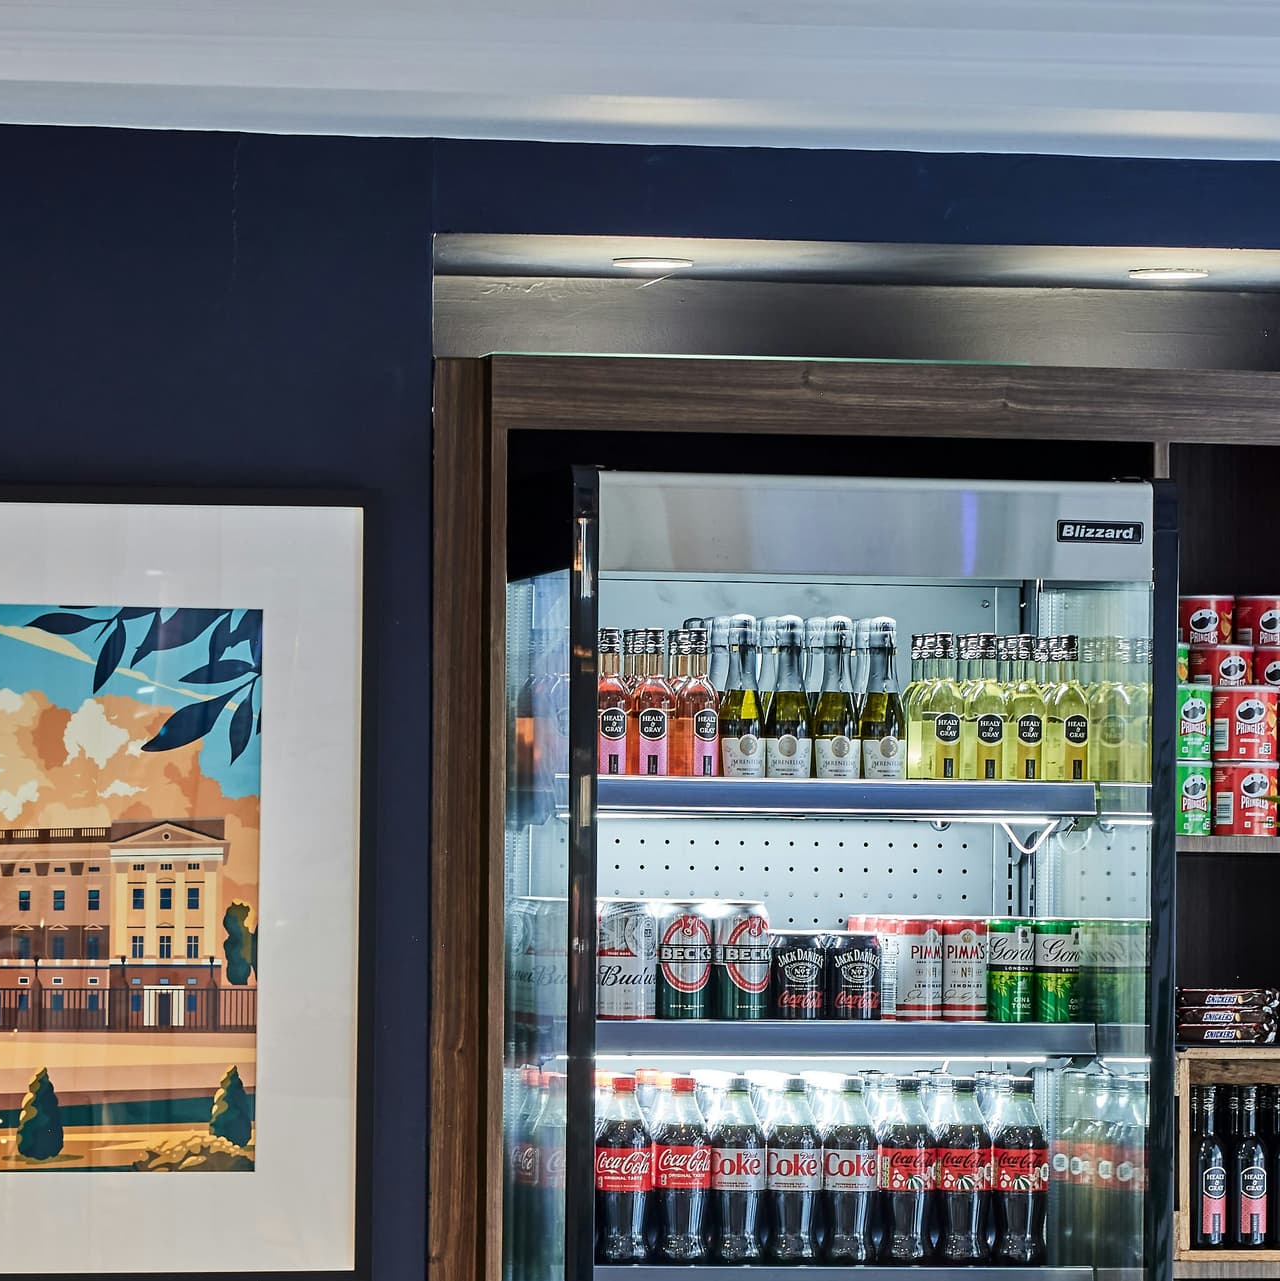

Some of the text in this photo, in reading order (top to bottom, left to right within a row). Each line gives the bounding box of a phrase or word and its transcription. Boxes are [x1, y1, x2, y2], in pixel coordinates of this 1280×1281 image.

[1062, 524, 1134, 539] Blizzard
[1190, 631, 1218, 644] PRINGLES
[1181, 720, 1206, 734] PRINGLES
[1235, 722, 1265, 735] PRINGLES
[1182, 796, 1207, 811] PRINGLES
[947, 942, 985, 959] PIMM'S
[777, 952, 796, 968] JACK
[834, 952, 853, 968] JACK
[1206, 996, 1236, 1004] SNICKERS
[1203, 1013, 1233, 1021] SNICKERS
[1205, 1030, 1234, 1038] SNICKERS
[597, 1151, 650, 1174] Coca-Cola
[711, 1152, 761, 1176] Coke
[768, 1152, 817, 1176] Coke
[825, 1153, 876, 1176] Coke
